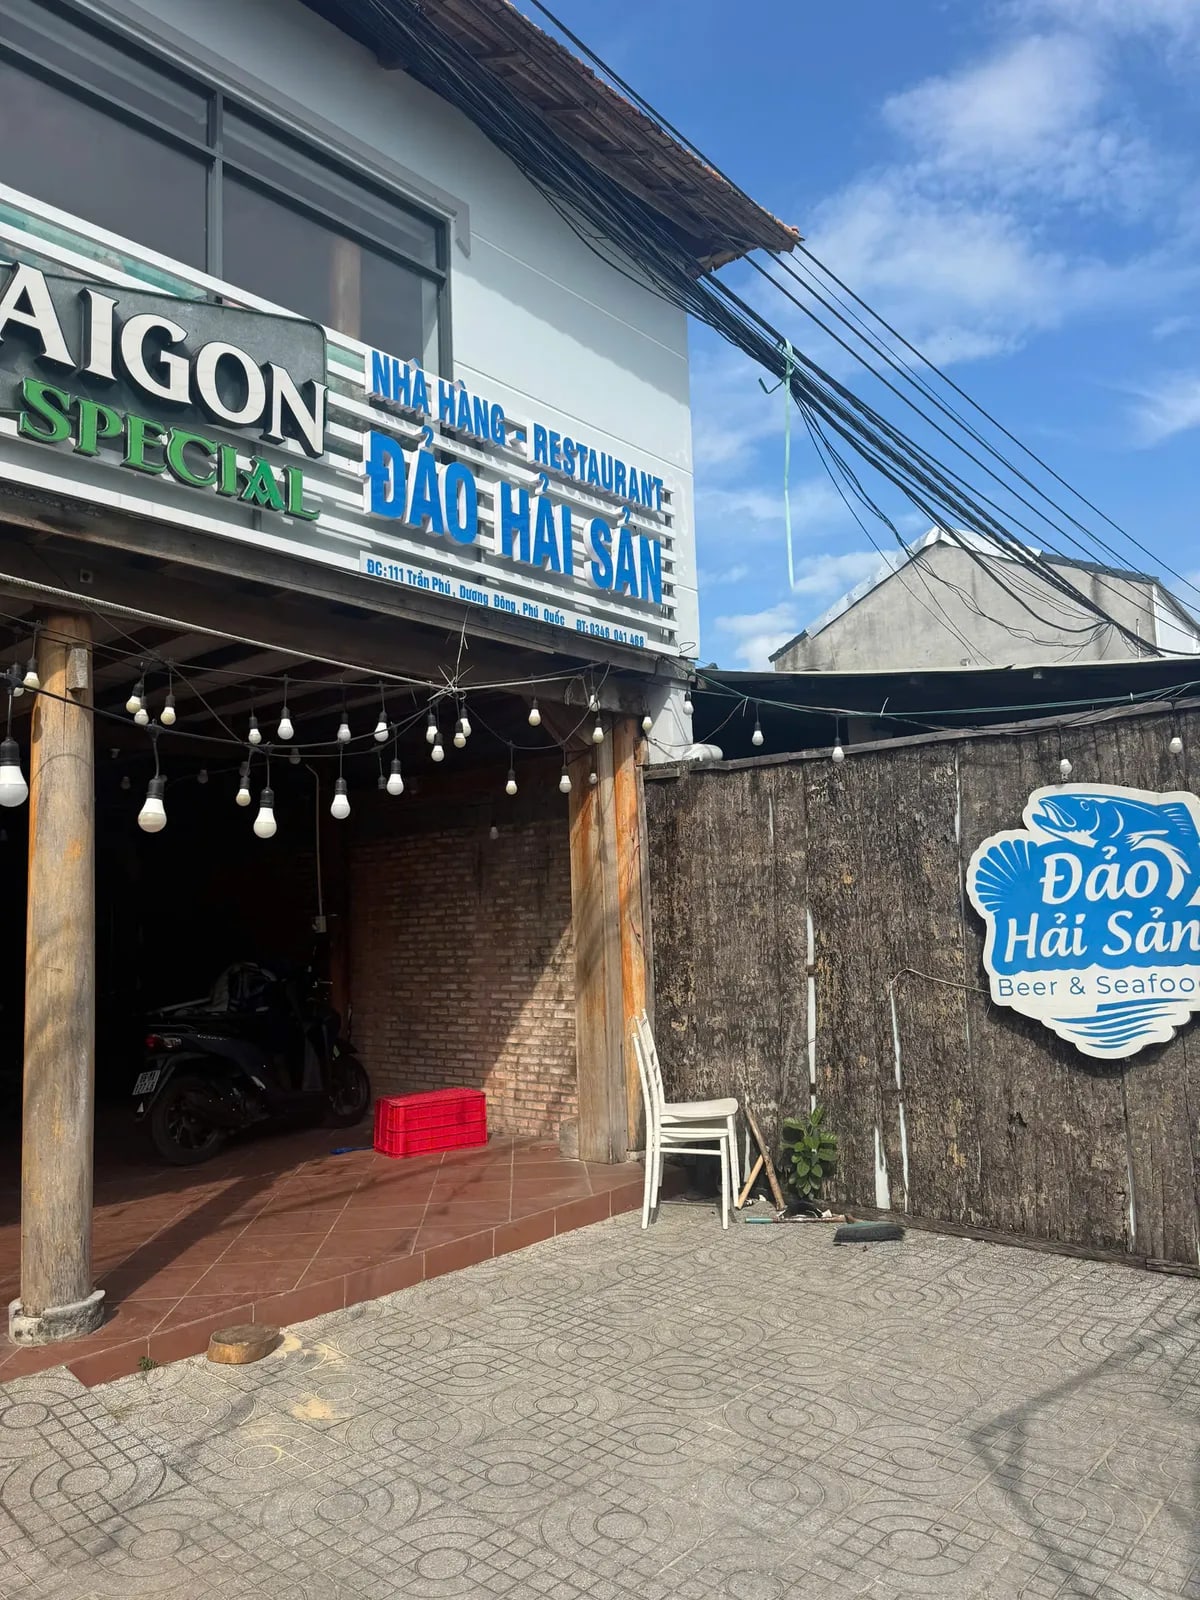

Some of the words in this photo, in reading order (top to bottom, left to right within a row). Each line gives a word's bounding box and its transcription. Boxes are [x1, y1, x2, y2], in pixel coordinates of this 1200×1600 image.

[18, 376, 320, 521] SPECIAL
[370, 350, 430, 414] NHÀ
[437, 379, 506, 446] HÀNG
[532, 422, 664, 512] RESTAURANT
[366, 425, 478, 545] ĐẢO
[499, 472, 574, 576] HẢI
[587, 505, 662, 605] SẢN
[406, 569, 430, 589] Trần
[523, 602, 539, 619] Phú
[543, 608, 565, 627] Quốc
[1040, 845, 1160, 905] Đảo
[1004, 912, 1088, 963] Hải
[1102, 906, 1200, 956] Sản
[998, 978, 1058, 997] Beer
[1069, 976, 1086, 996] &
[1096, 972, 1200, 995] Seafoo
